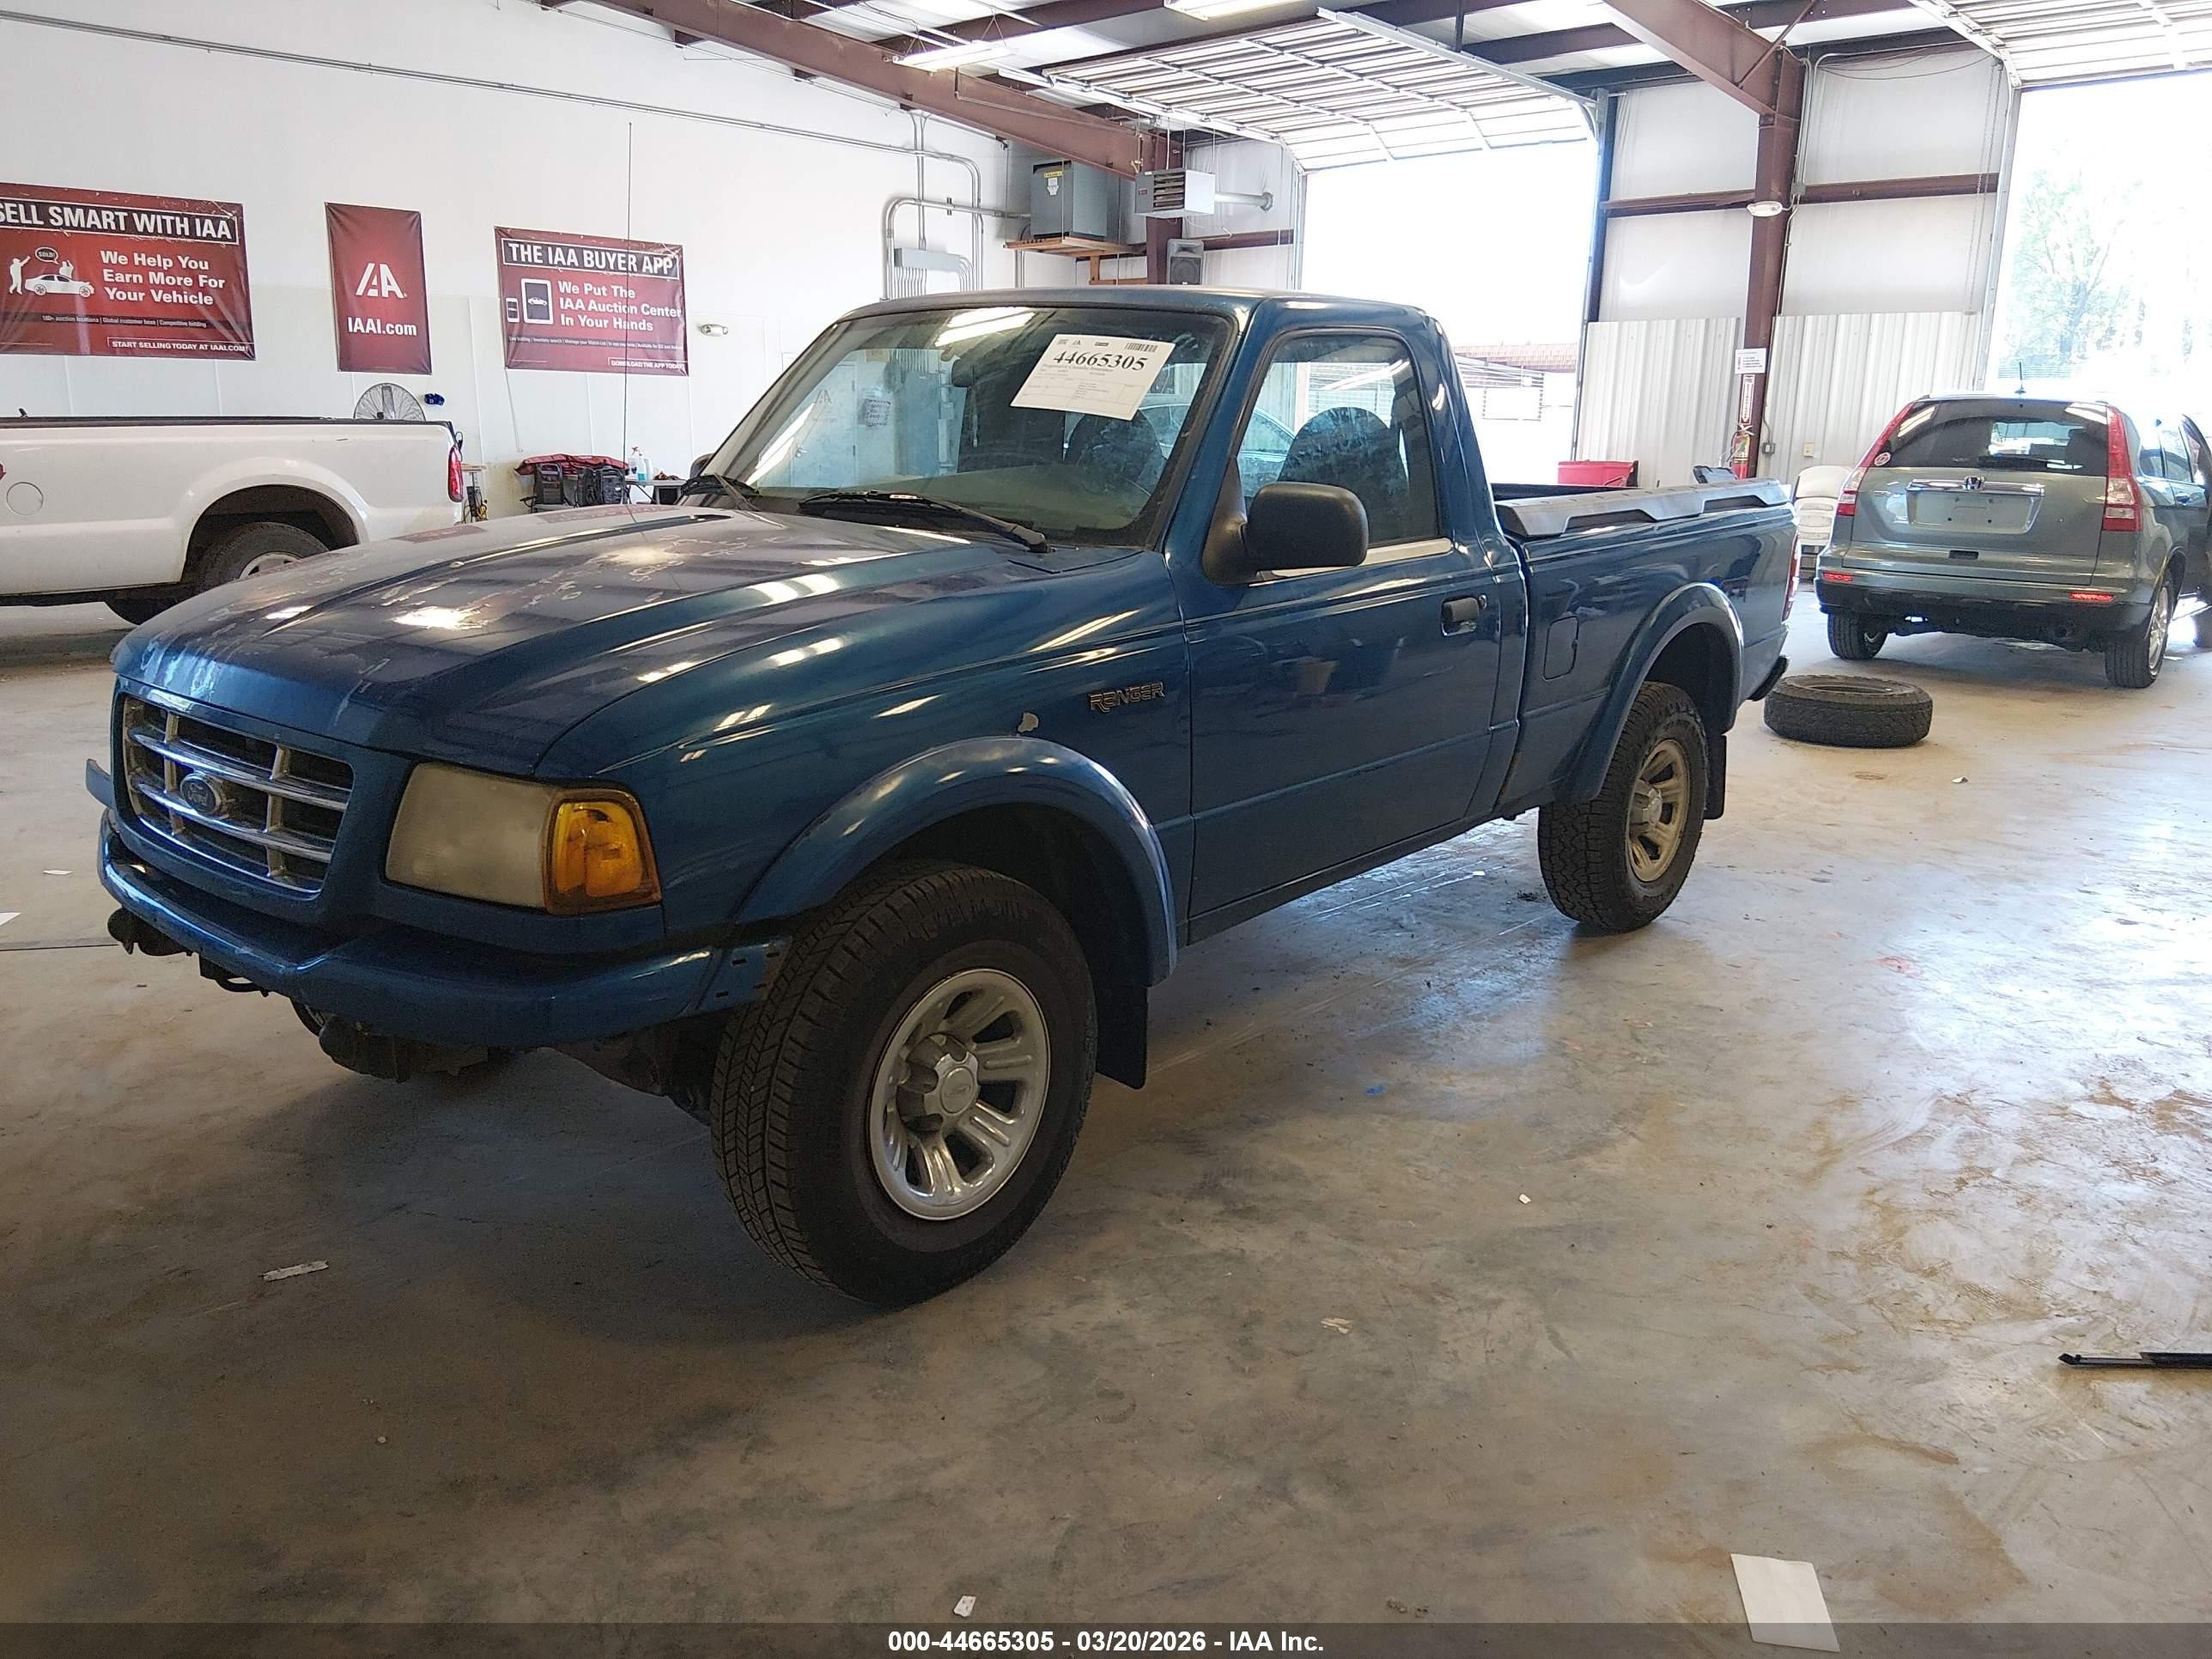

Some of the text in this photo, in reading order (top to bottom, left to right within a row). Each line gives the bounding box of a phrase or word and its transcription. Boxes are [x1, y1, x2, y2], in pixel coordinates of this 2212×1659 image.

[48, 205, 129, 231] SMART
[132, 212, 190, 235] WITH
[194, 218, 233, 240] IAA
[100, 250, 210, 270] We Help You
[507, 243, 673, 275] THE IAA BUYER APP
[103, 269, 226, 289] Earn More For
[104, 287, 214, 306] Your Vehicle
[558, 281, 635, 298] We Put The
[559, 297, 681, 318] IAA Auction Center
[348, 317, 417, 336] IAAI.com
[561, 313, 653, 331] In Your Hands
[1054, 350, 1148, 371] 44665305
